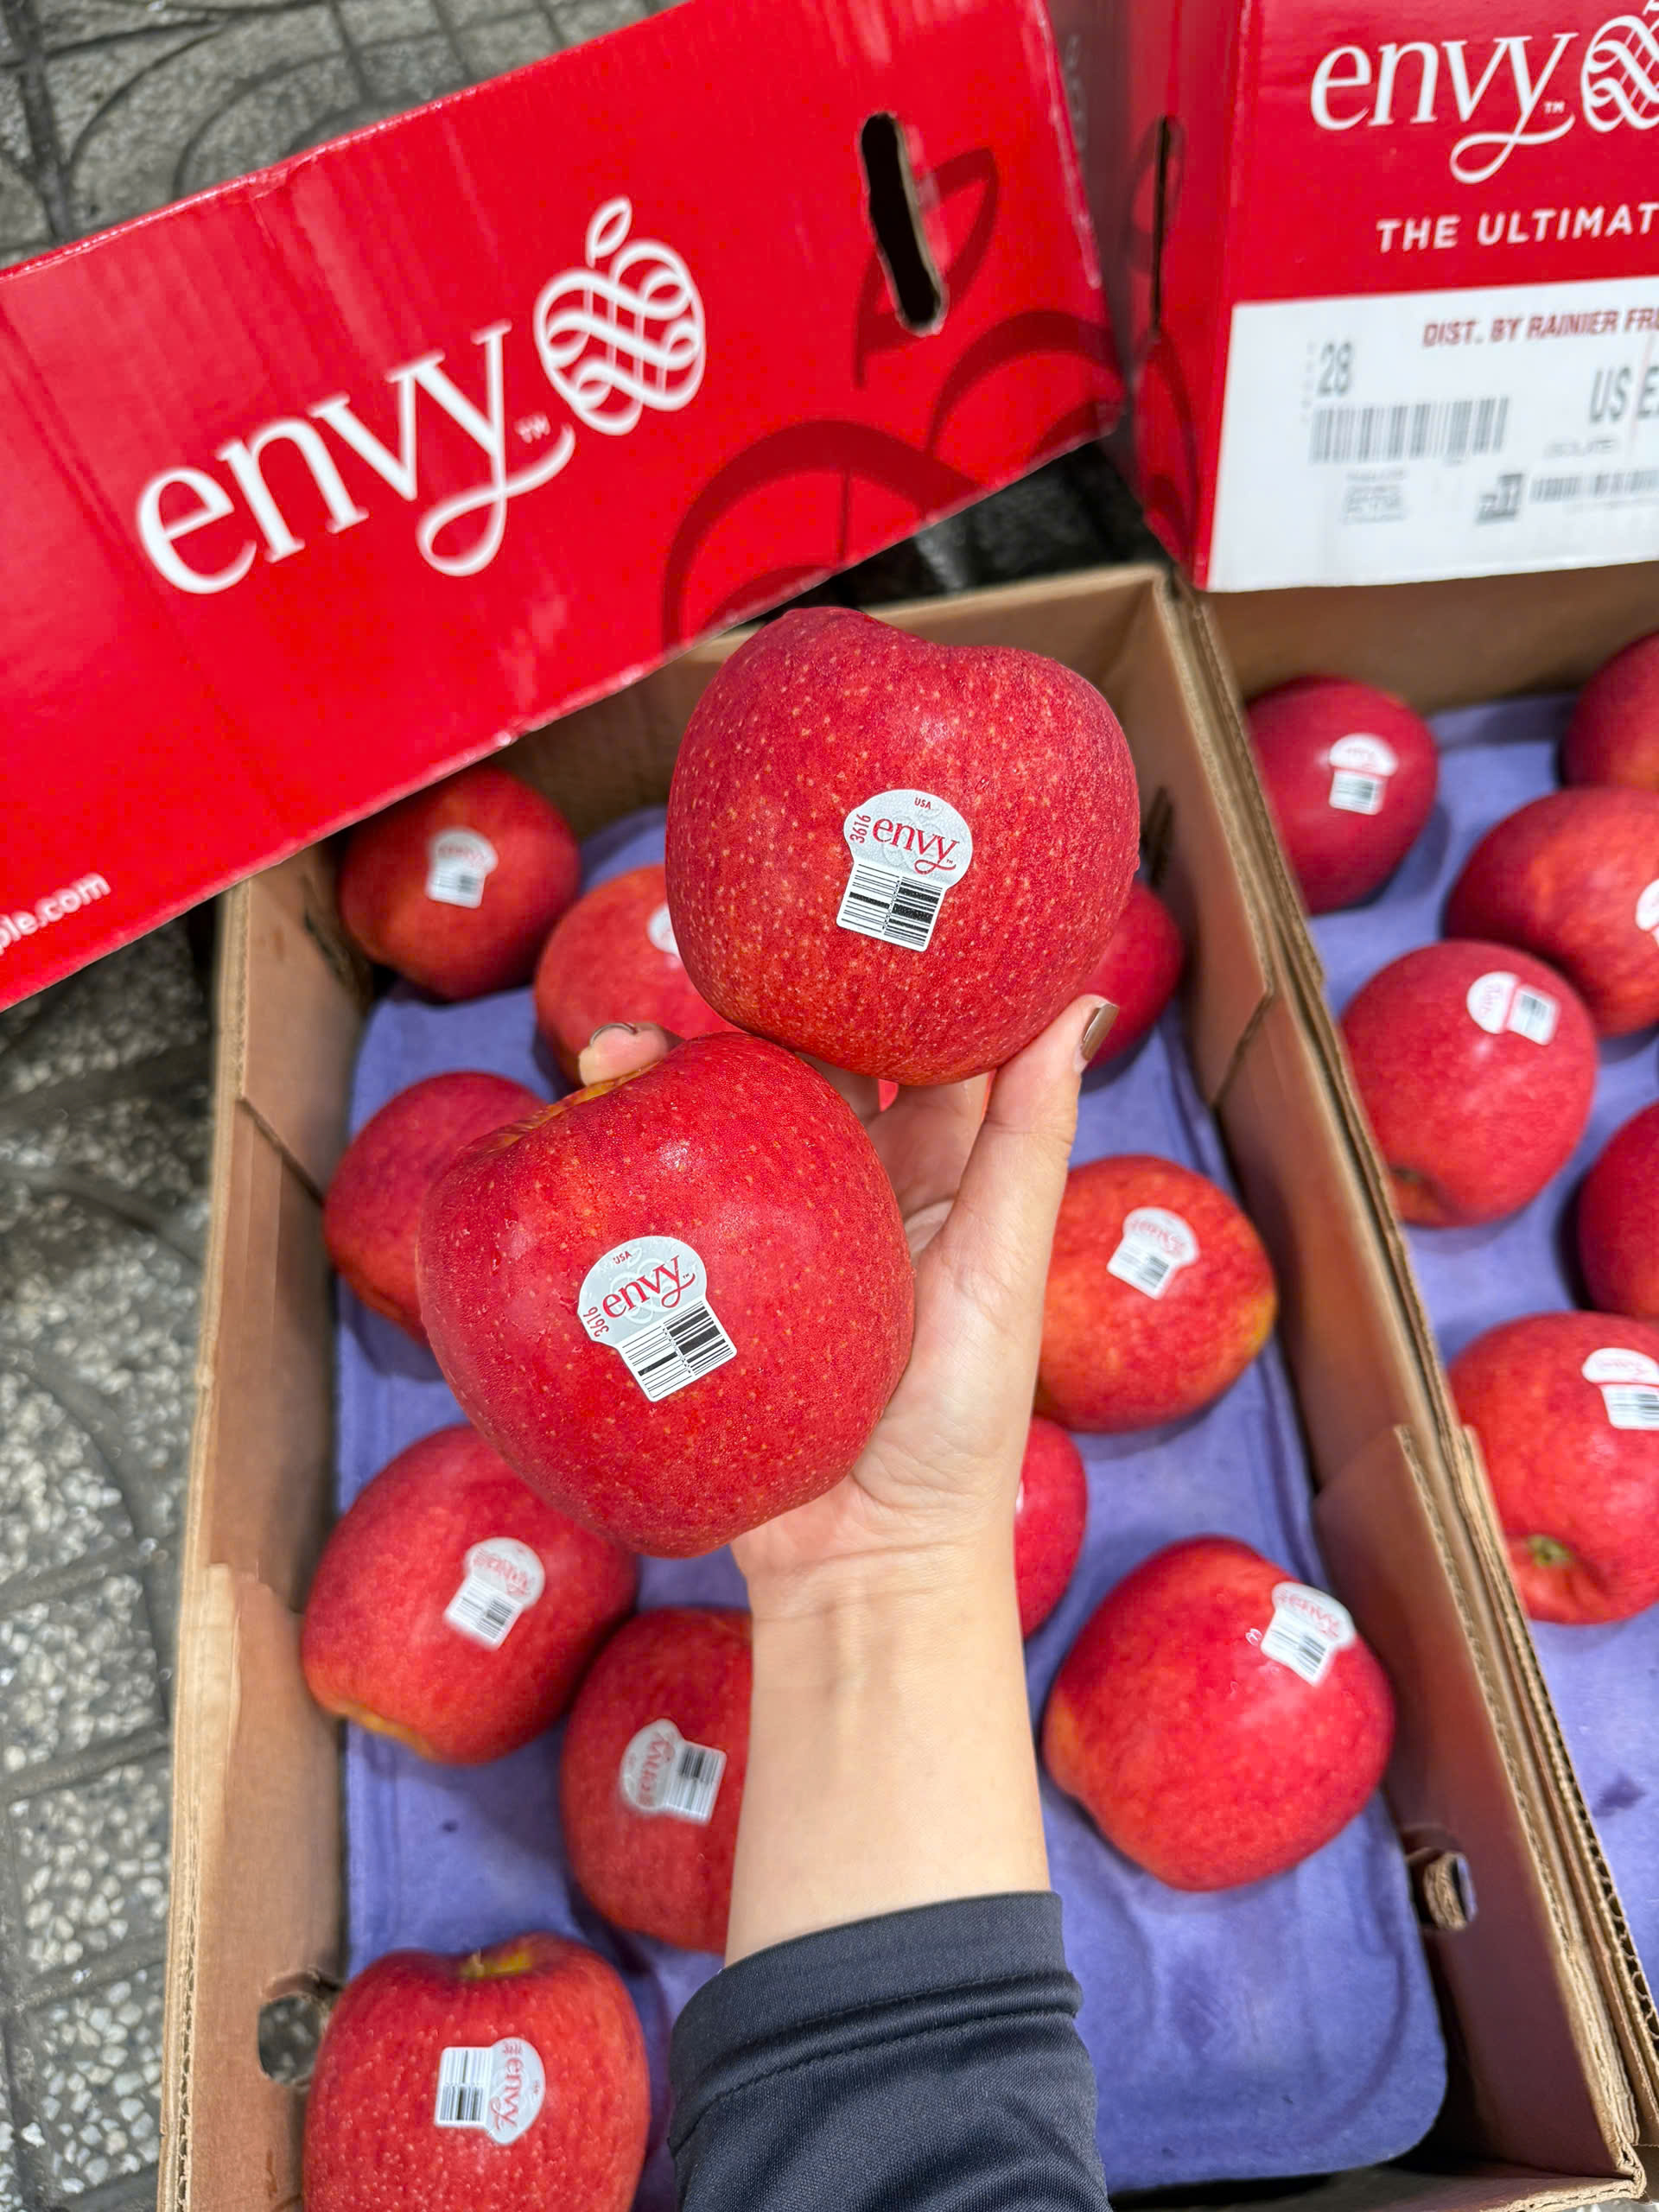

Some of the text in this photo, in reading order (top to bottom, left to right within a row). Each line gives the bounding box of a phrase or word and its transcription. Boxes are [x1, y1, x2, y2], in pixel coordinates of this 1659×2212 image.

[1310, 32, 1580, 185] envy
[1376, 201, 1659, 254] THE ULTIMAT
[1422, 307, 1659, 347] DIST. BY RAINIER FR
[1589, 365, 1633, 424] US
[136, 320, 575, 595] envy
[849, 814, 872, 844] 3616
[914, 797, 932, 810] USA
[872, 817, 960, 876] envy
[613, 1250, 632, 1265] USA
[602, 1255, 696, 1319] envy
[583, 1306, 609, 1338] 3616
